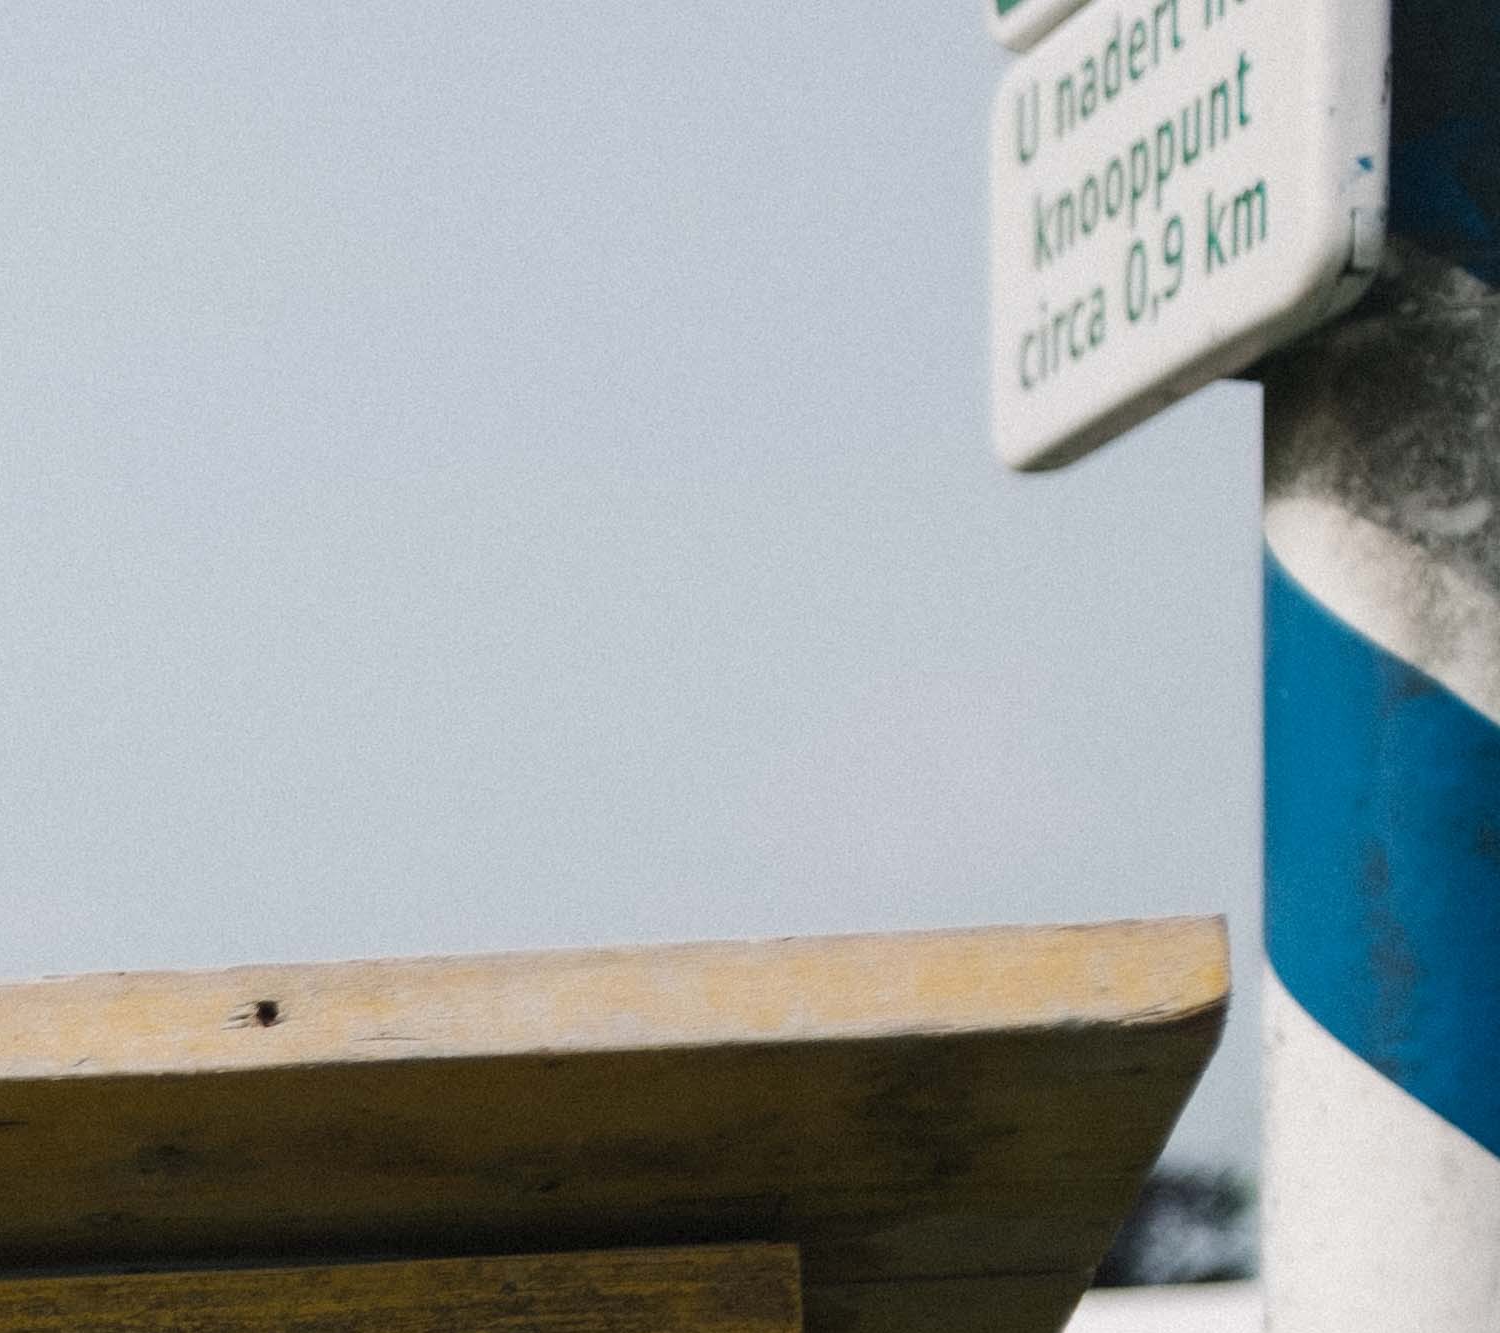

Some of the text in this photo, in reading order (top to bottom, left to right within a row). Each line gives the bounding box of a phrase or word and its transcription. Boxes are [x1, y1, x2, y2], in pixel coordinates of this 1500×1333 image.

[1016, 0, 1185, 163] U nadert
[1032, 52, 1251, 271] knooppunt
[1018, 286, 1105, 391] circa
[1205, 178, 1267, 275] km
